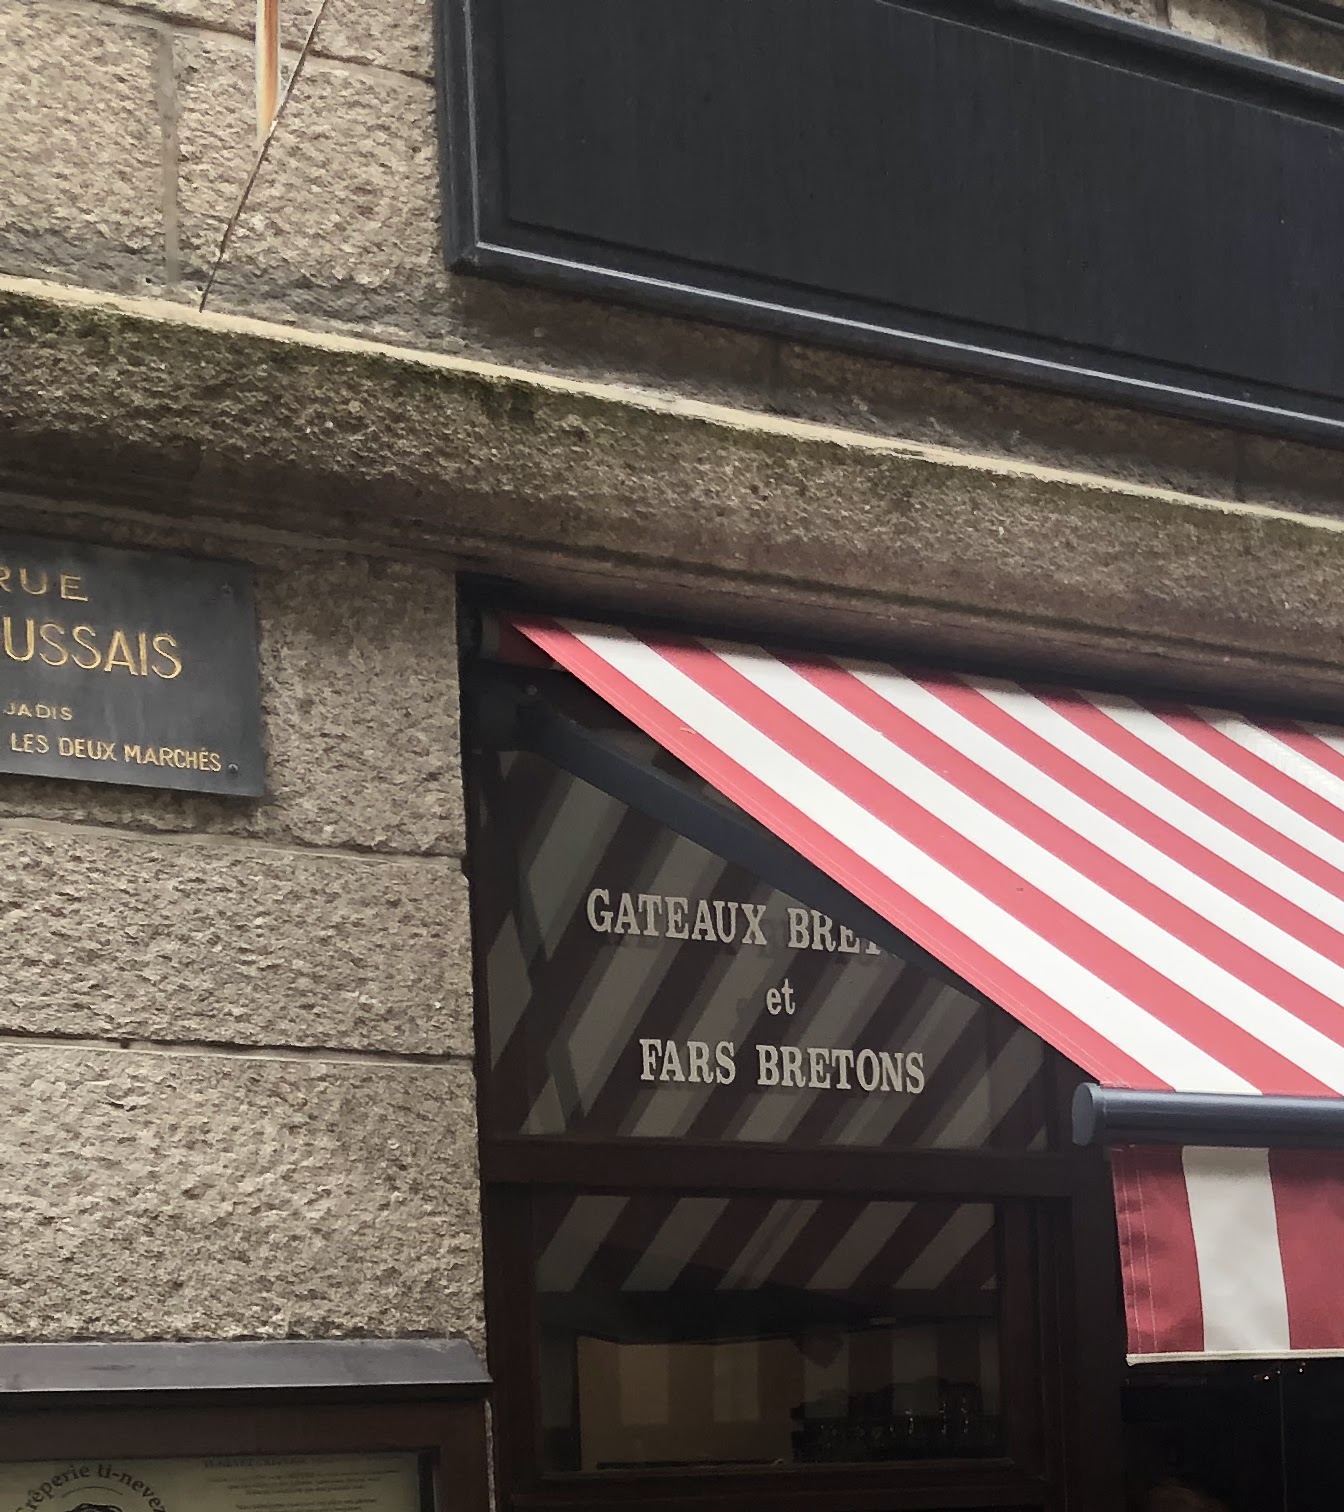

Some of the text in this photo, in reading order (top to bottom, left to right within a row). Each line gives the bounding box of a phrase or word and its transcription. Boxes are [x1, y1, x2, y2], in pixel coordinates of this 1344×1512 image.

[0, 566, 89, 602] RUE
[4, 703, 73, 721] JADIS
[11, 732, 49, 754] LES
[58, 737, 117, 761] DEUX
[586, 887, 767, 946] GATEAUX
[766, 978, 796, 1015] et
[639, 1038, 925, 1095] FARS BRETONS
